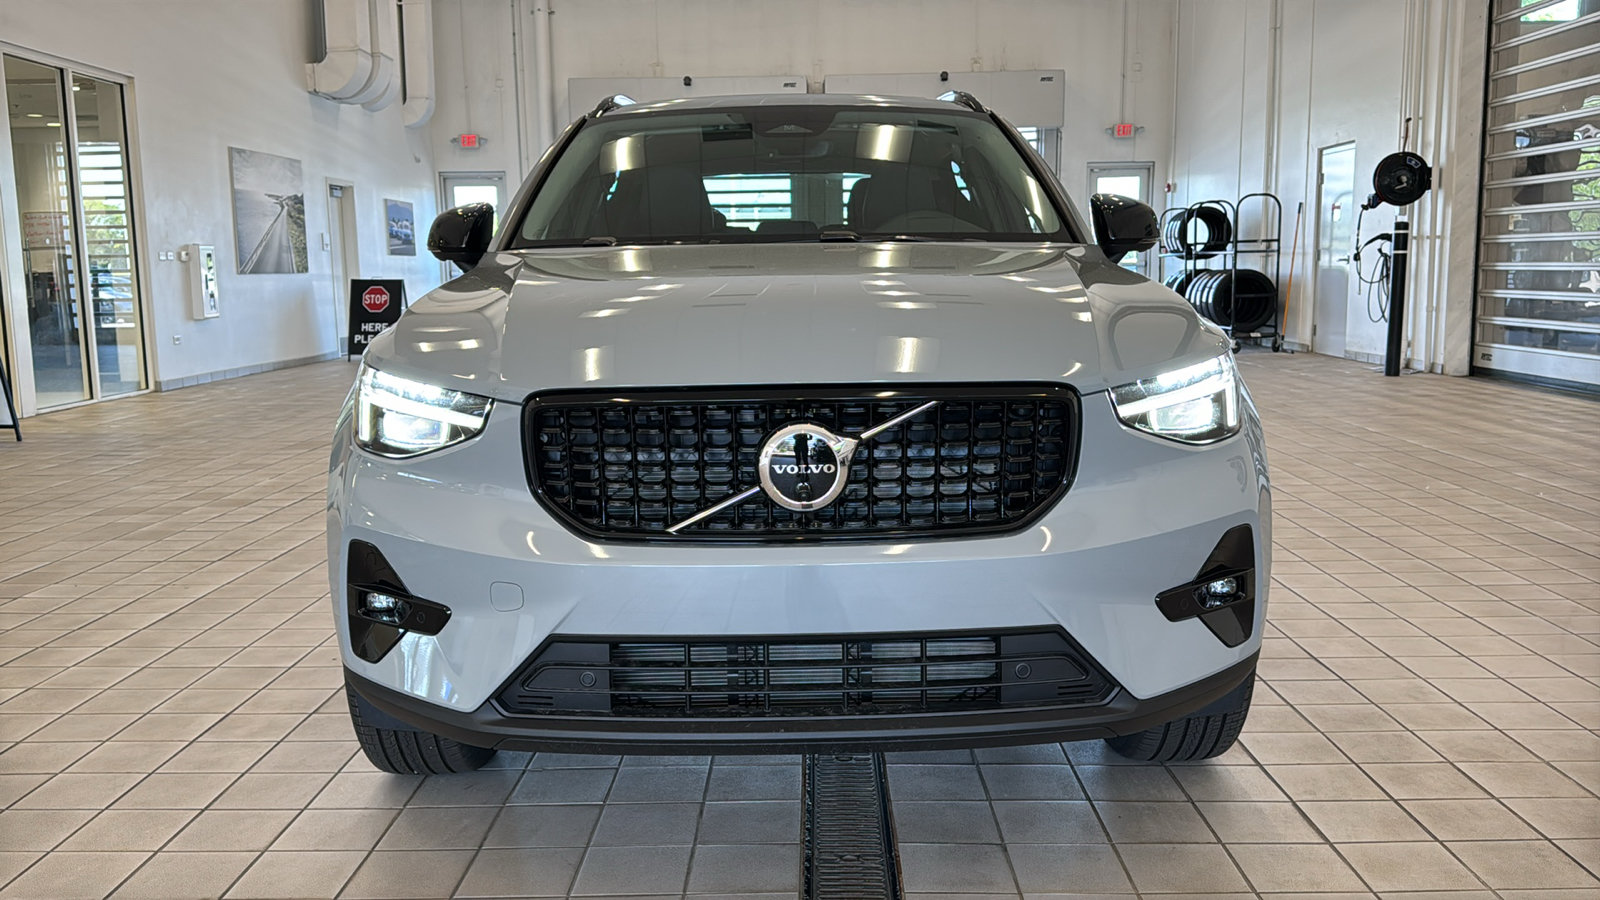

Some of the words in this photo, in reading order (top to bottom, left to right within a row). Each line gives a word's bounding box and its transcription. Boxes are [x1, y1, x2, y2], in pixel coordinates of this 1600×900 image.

[1117, 124, 1132, 136] EXIT
[461, 134, 476, 147] EXIT
[364, 294, 388, 304] STOP
[361, 323, 389, 332] HERE
[354, 335, 374, 344] PLE
[772, 464, 836, 474] VOLVO
